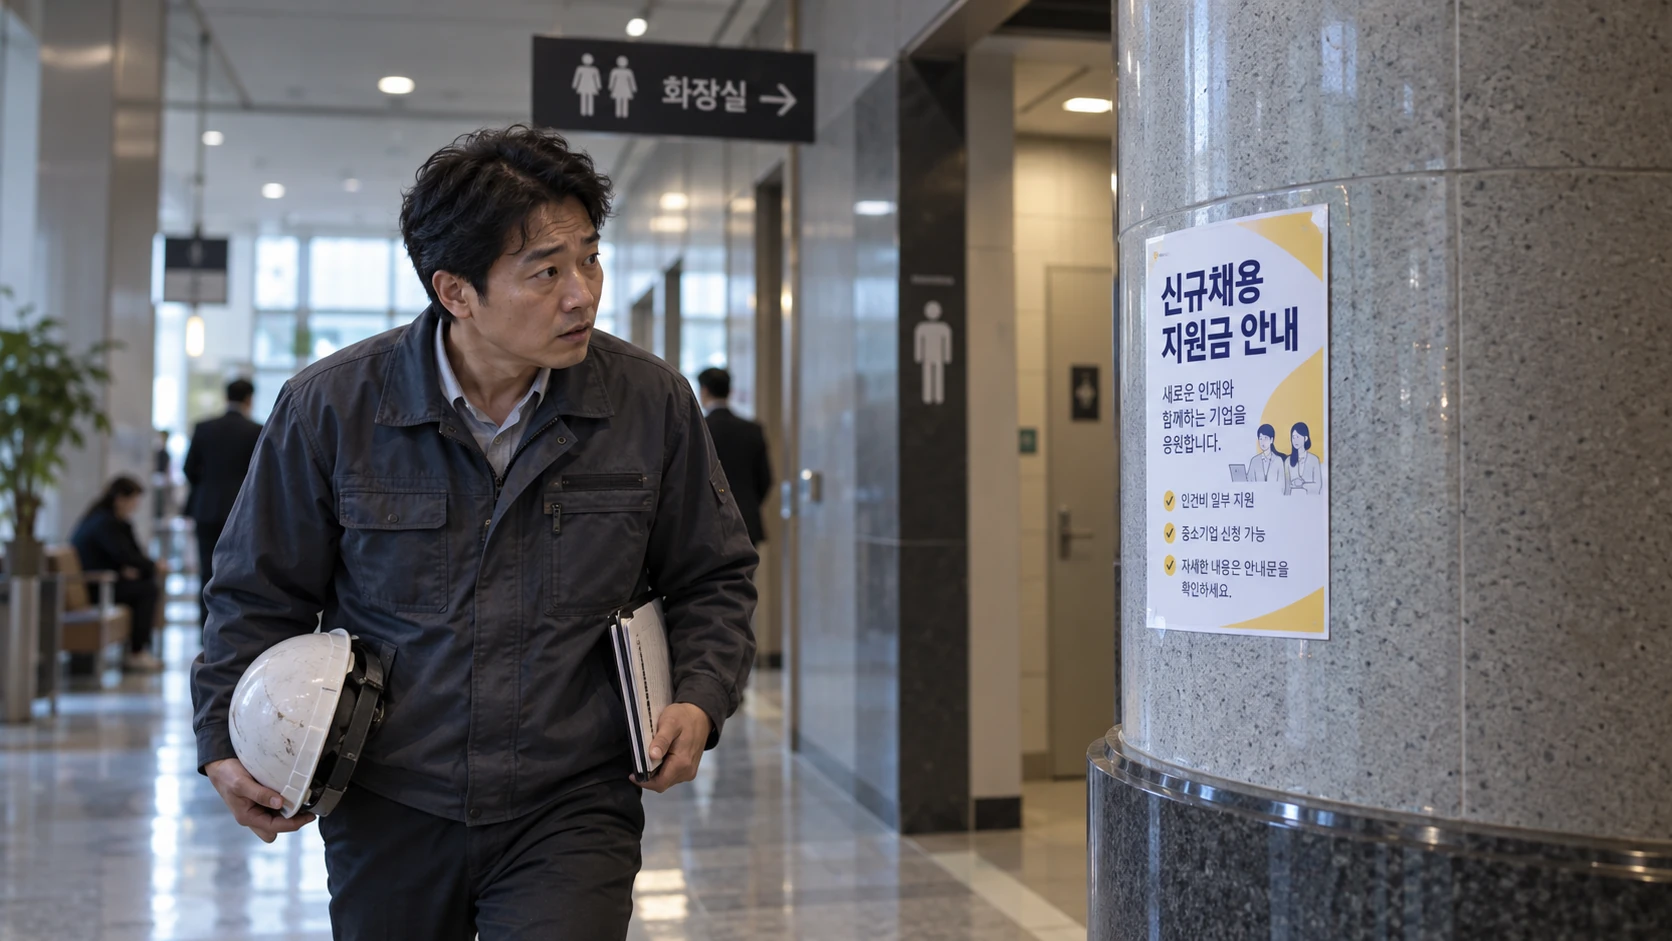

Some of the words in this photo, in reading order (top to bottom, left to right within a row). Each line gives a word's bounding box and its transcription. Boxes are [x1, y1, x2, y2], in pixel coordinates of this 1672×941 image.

[661, 75, 747, 113] 화장실
[1161, 259, 1264, 317] 신규채용
[1161, 316, 1233, 364] 지원금
[1241, 306, 1298, 356] 안내
[1162, 383, 1195, 404] 새로운
[1198, 379, 1234, 401] 인재와
[1162, 408, 1206, 429] 함께하는
[1209, 404, 1246, 426] 기업을
[1162, 433, 1221, 454] 응원합니다.
[1181, 492, 1208, 508] 인건비
[1211, 492, 1230, 508] 일부
[1233, 492, 1254, 508] 지원
[1181, 526, 1218, 542] 중소기업
[1221, 526, 1241, 542] 신청
[1244, 526, 1266, 543] 가능
[1181, 558, 1208, 575] 자세한
[1244, 560, 1289, 578] 안내문을
[1181, 581, 1232, 598] 확인하세요.
